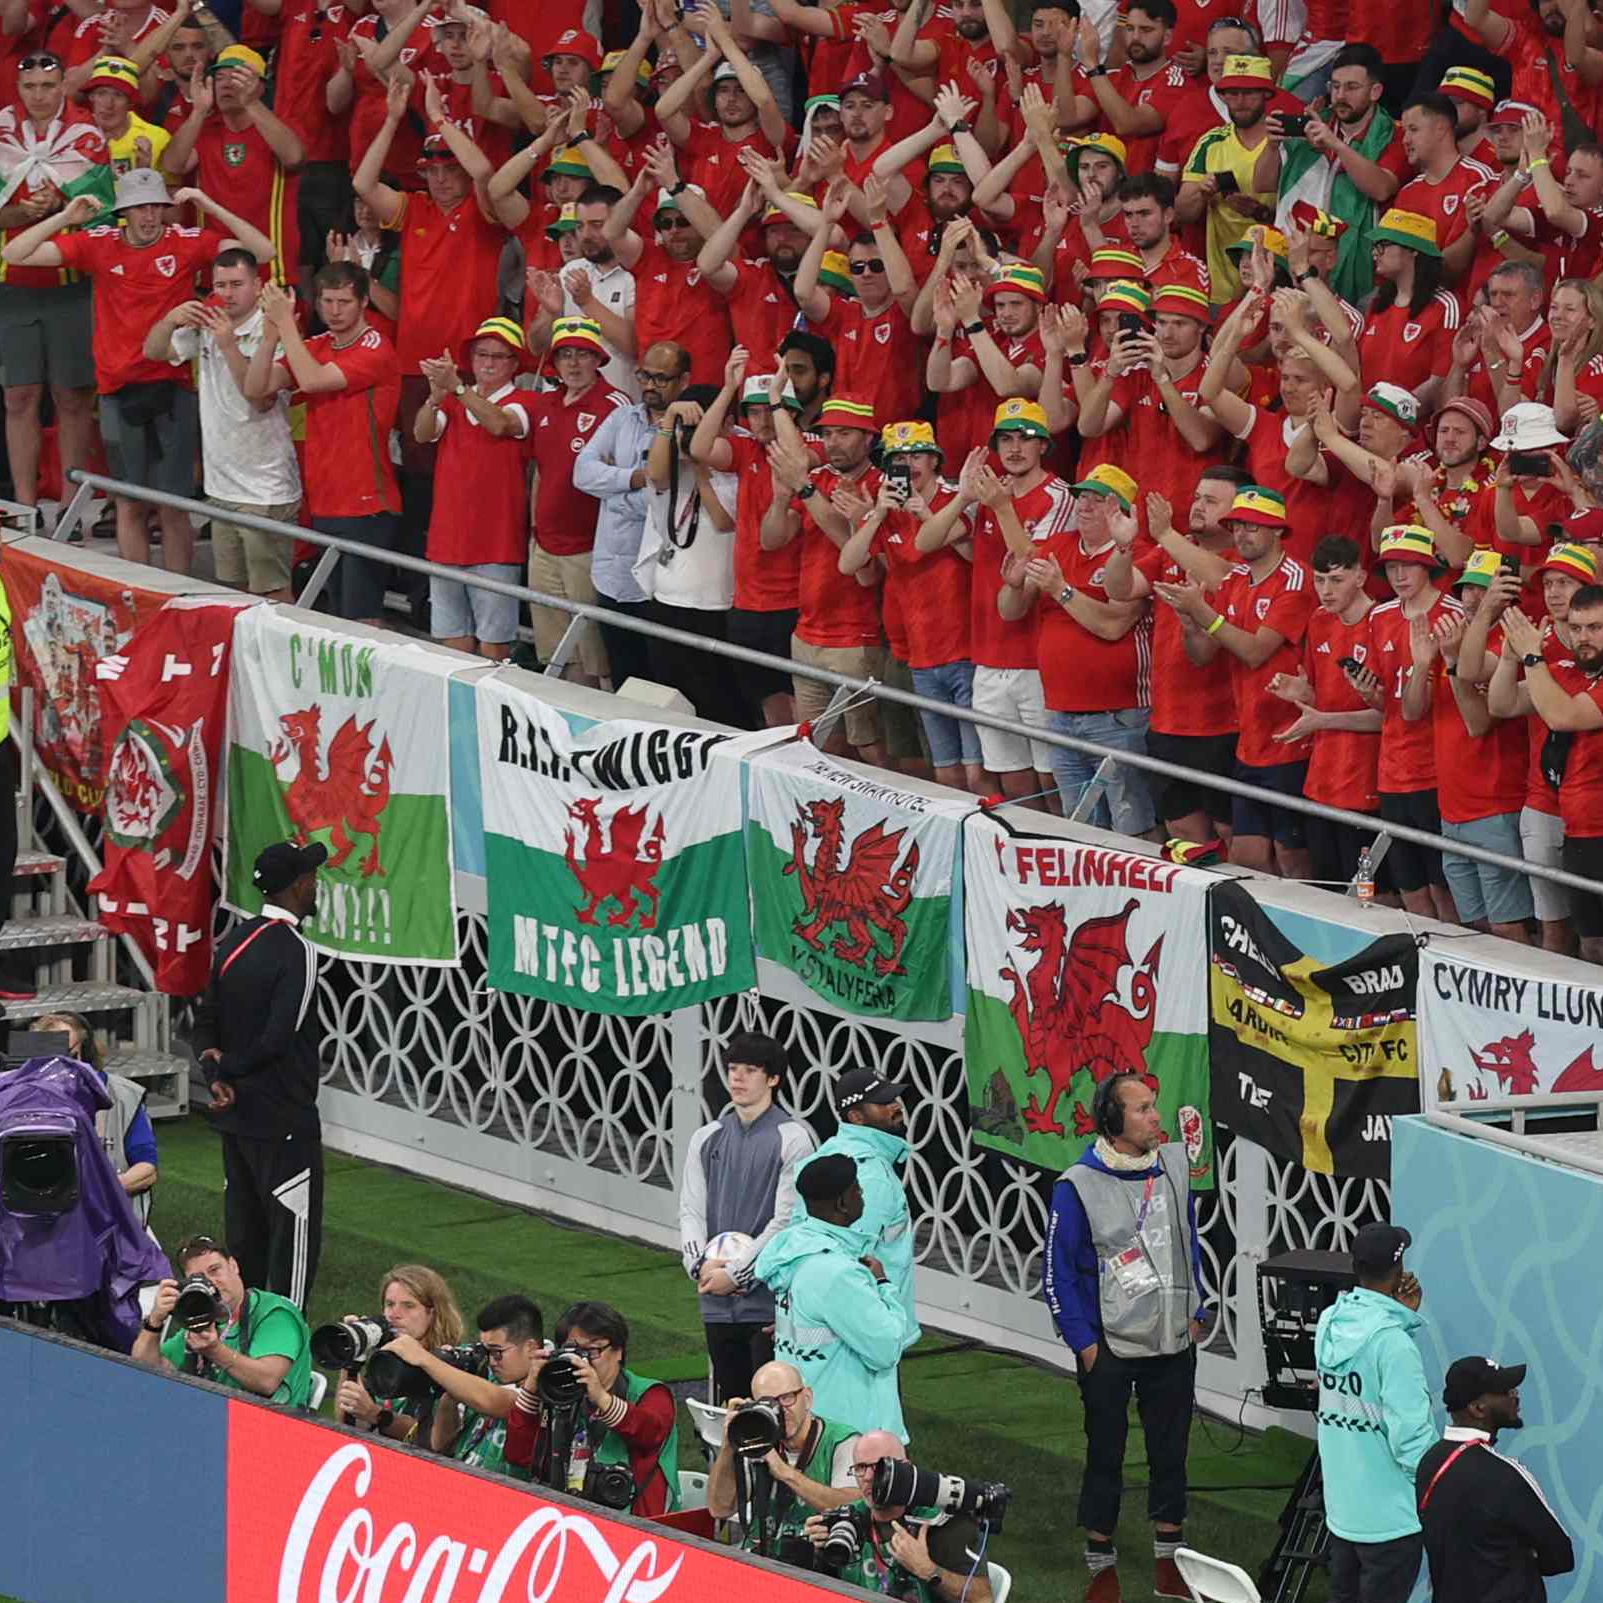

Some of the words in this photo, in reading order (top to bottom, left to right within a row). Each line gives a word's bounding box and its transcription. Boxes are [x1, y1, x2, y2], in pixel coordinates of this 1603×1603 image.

[513, 913, 601, 994] MTFC
[613, 917, 727, 997] LEGEND
[1342, 964, 1405, 995] BRAD
[1434, 962, 1530, 1013] CYMRY
